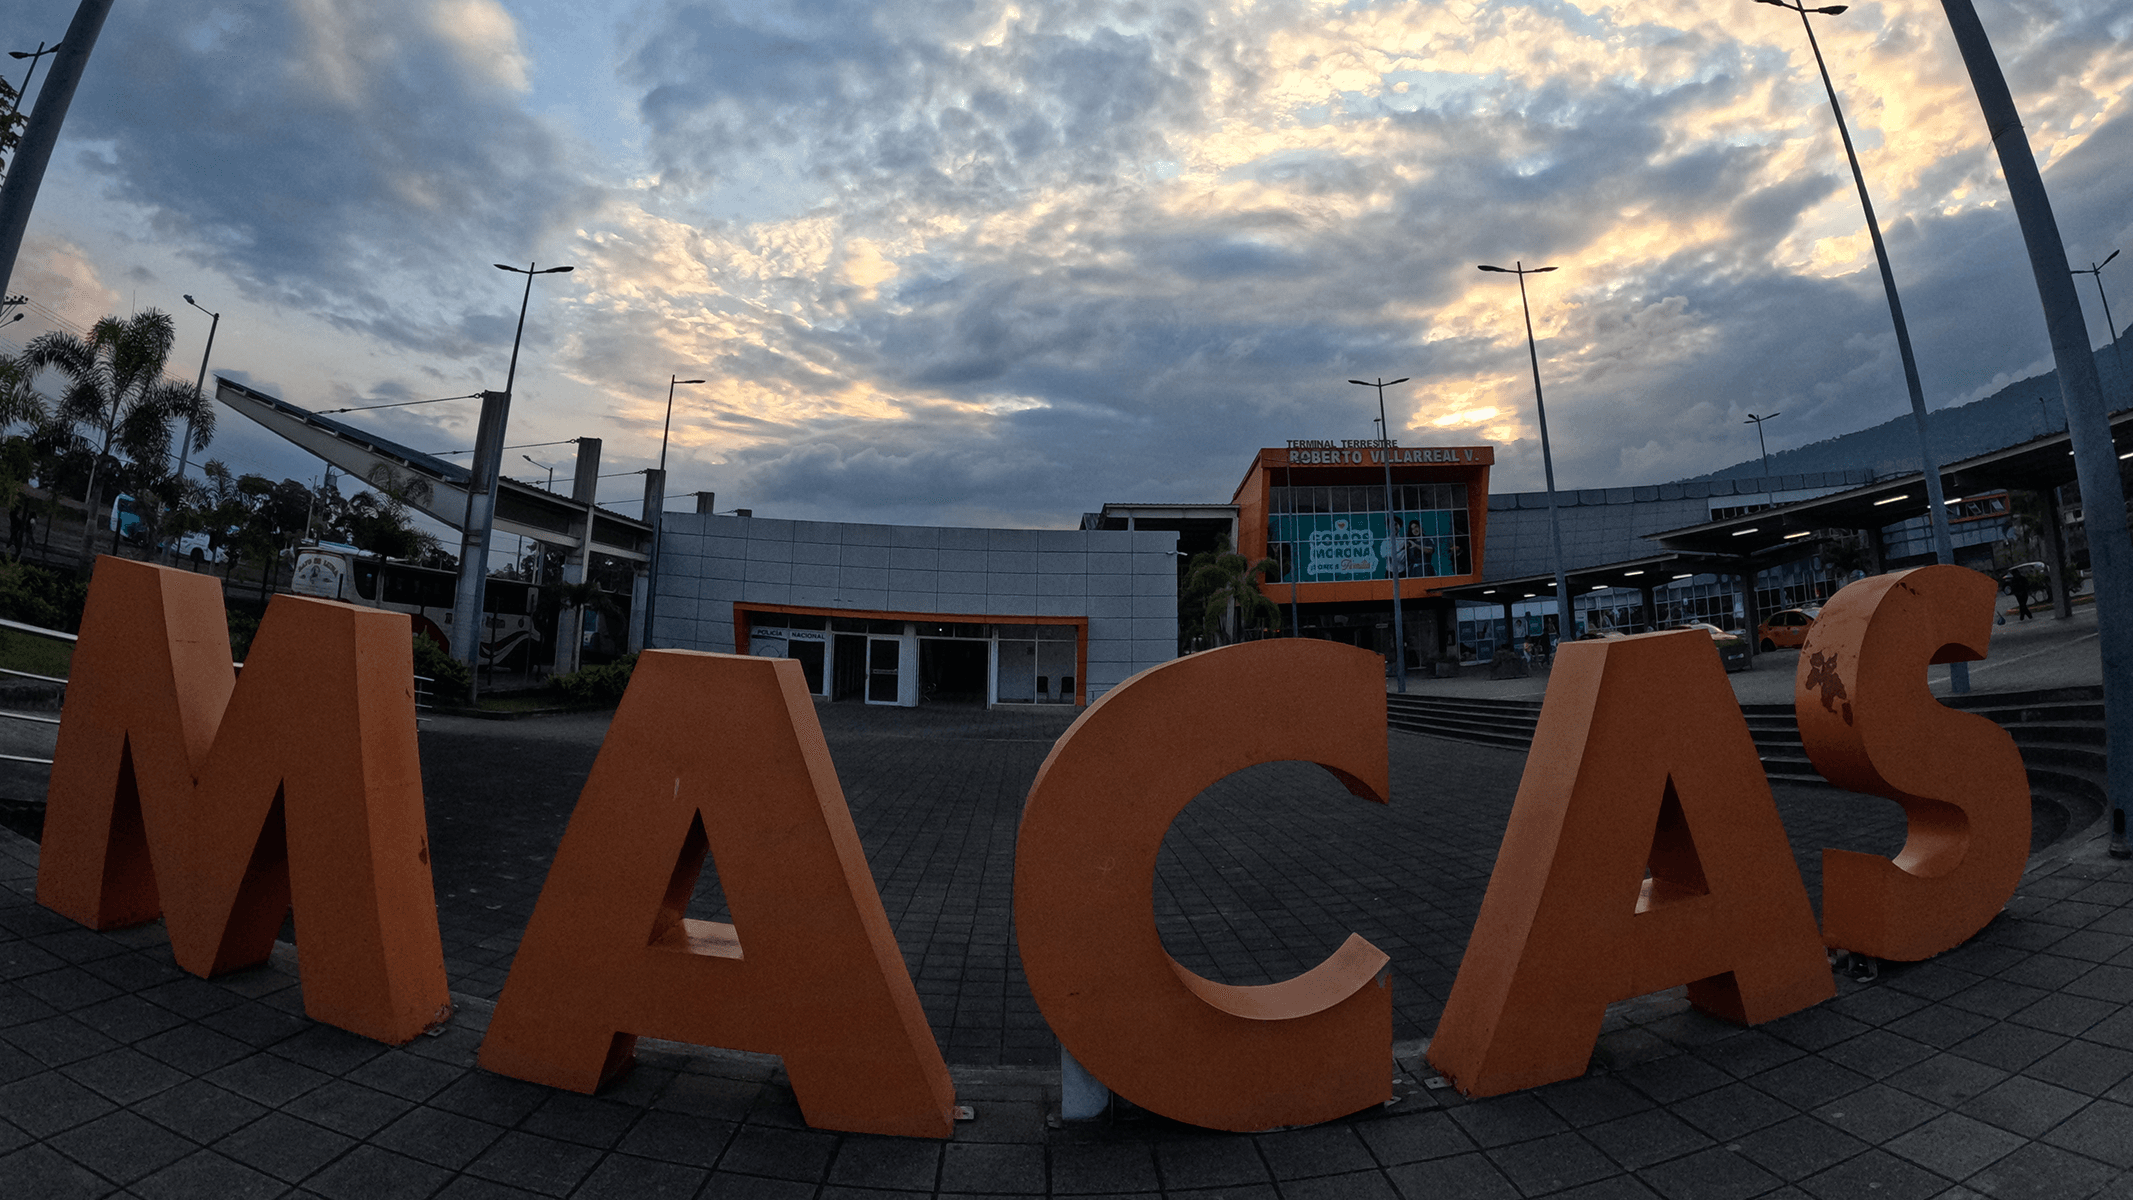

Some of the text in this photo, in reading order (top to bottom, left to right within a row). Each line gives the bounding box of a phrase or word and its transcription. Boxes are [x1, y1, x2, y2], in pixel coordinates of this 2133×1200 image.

[1286, 439, 1398, 449] TERMINAL TERRESTRE
[1289, 450, 1362, 465] ROBERTO
[1371, 449, 1460, 464] VILLARREAL
[1313, 532, 1370, 546] SOMOS
[1313, 547, 1370, 559] MORONA
[791, 632, 825, 640] NACIONAL
[36, 555, 2033, 1140] MACAS
